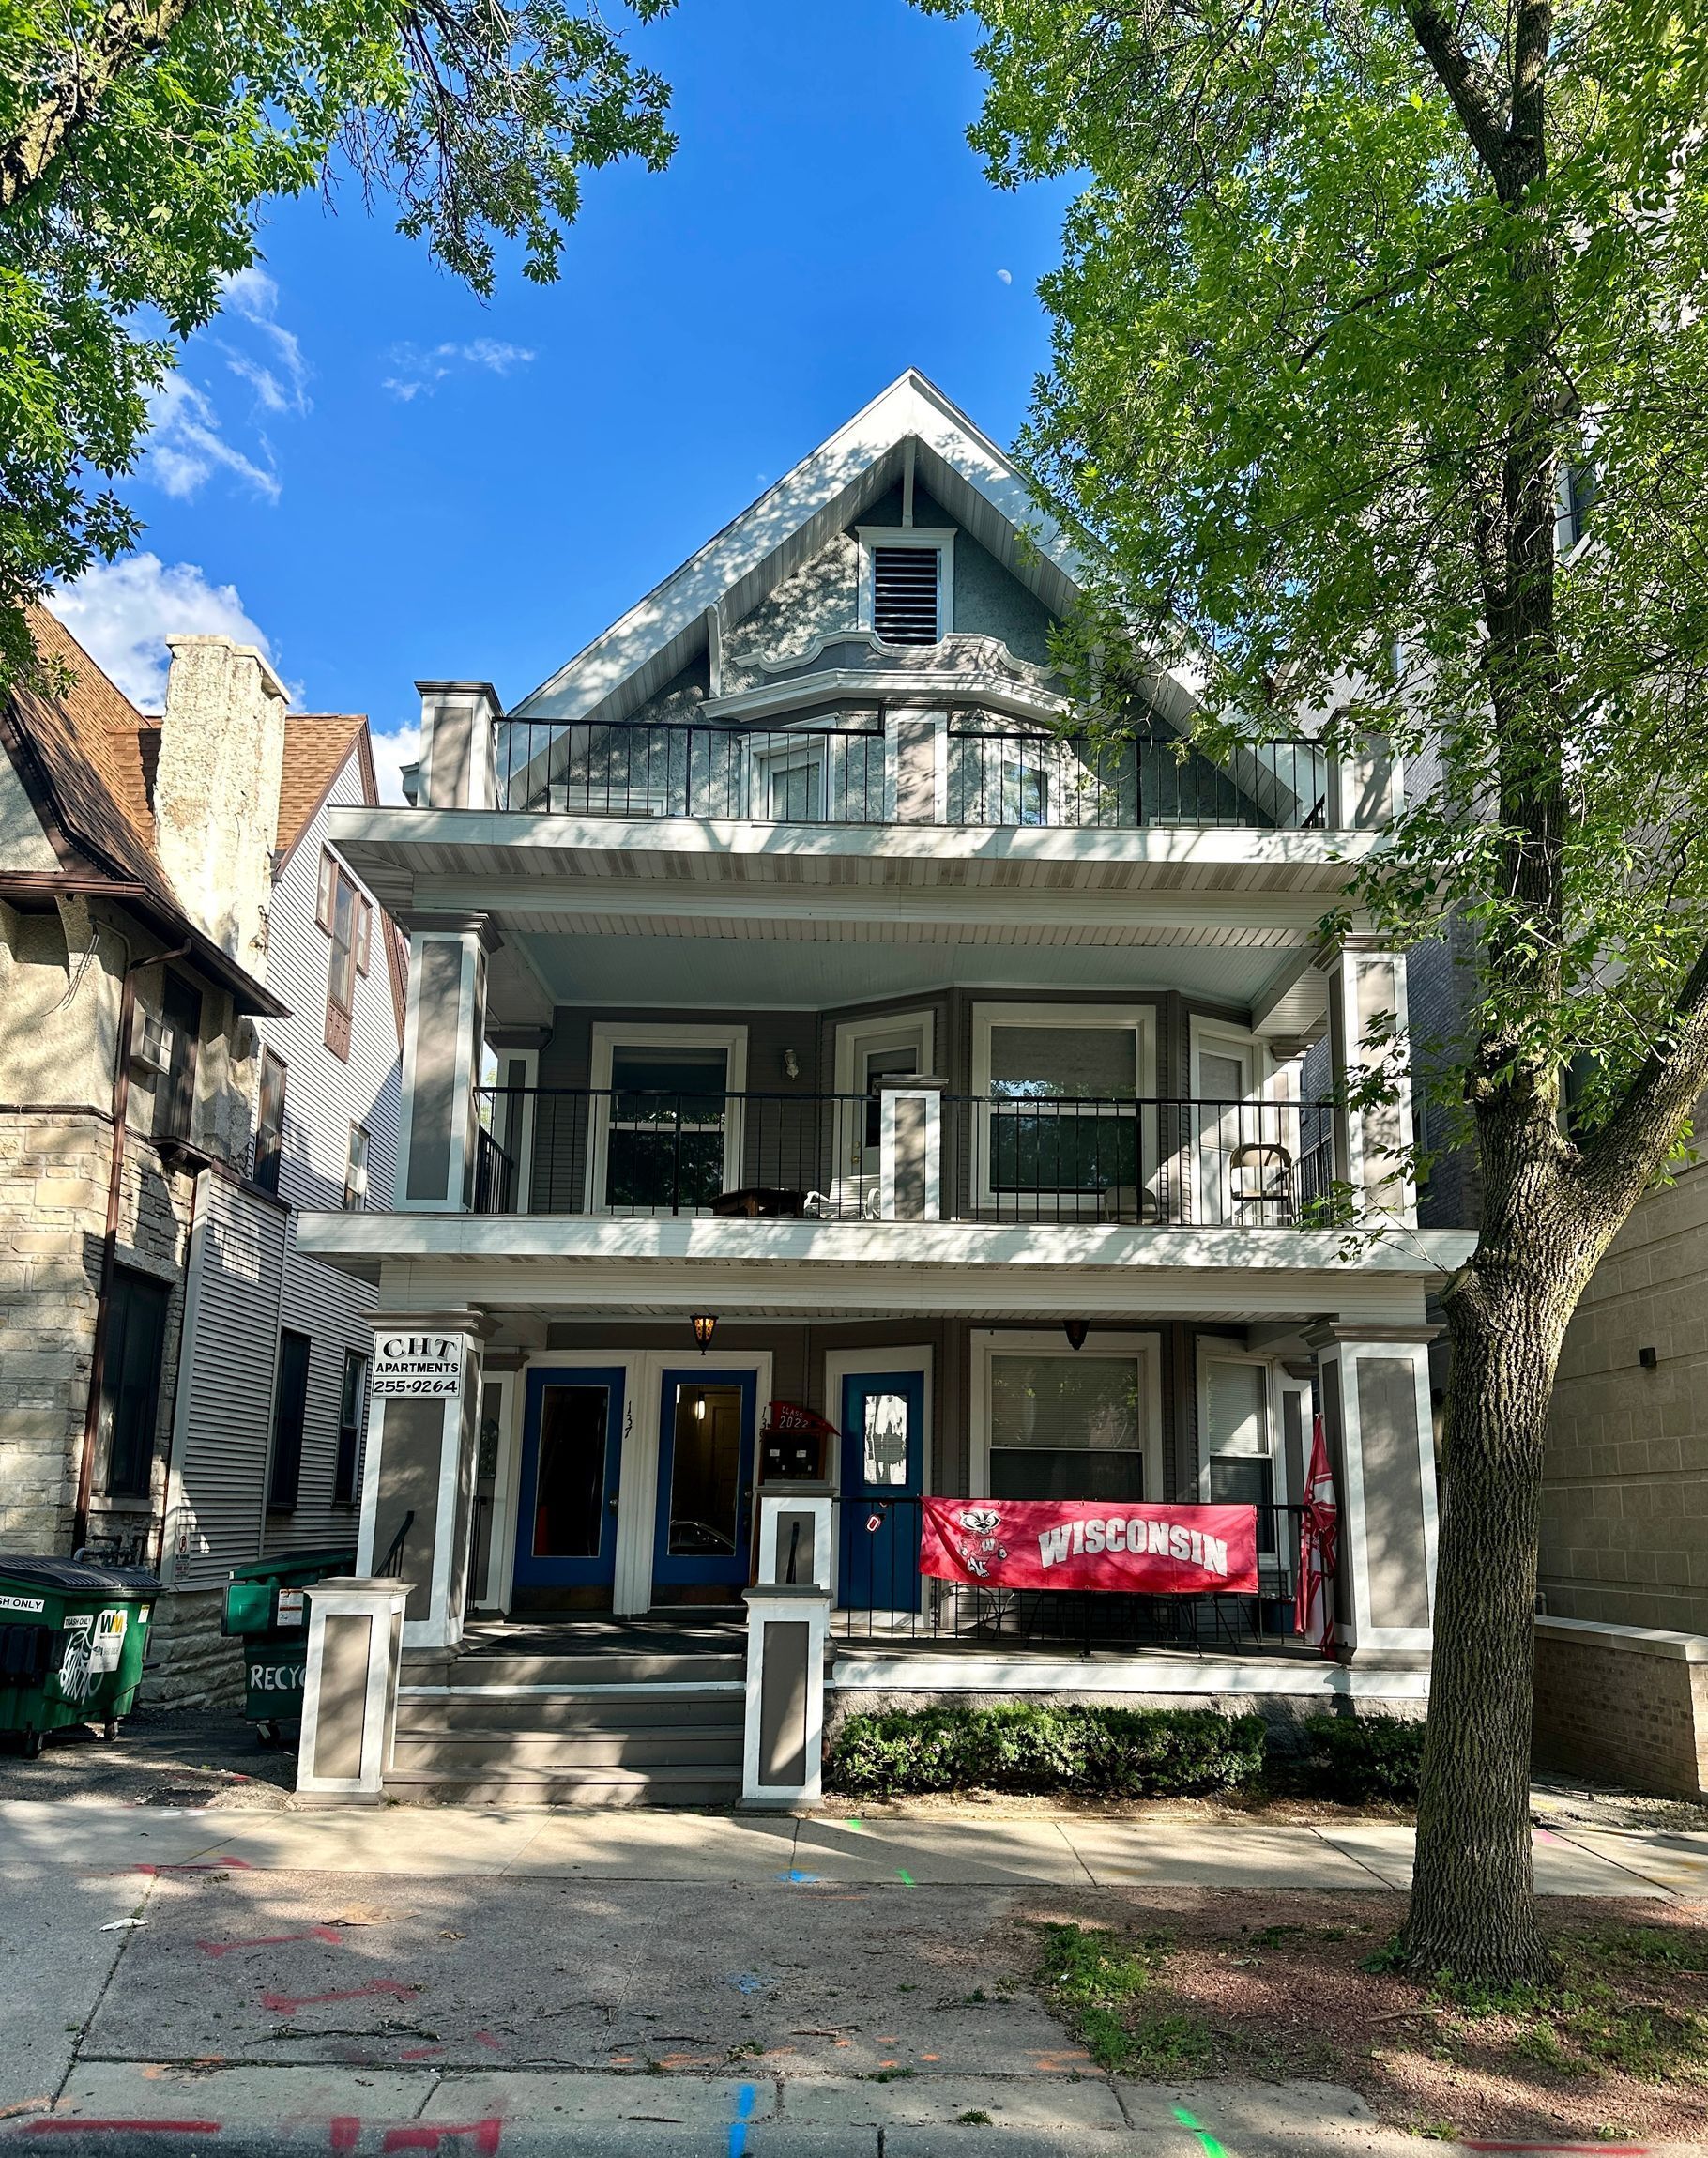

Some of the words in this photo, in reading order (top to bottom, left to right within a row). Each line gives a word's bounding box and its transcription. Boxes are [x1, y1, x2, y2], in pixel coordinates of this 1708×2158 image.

[383, 1338, 457, 1361] CHT
[375, 1363, 459, 1373] APARTMENTS
[782, 1406, 803, 1417] CLASS
[624, 1400, 633, 1439] 137
[779, 1416, 809, 1429] 2022
[1038, 1517, 1228, 1577] WISCONSIN
[13, 1599, 42, 1609] ONLY
[65, 1617, 79, 1626] TRASH
[100, 1615, 124, 1633] WM
